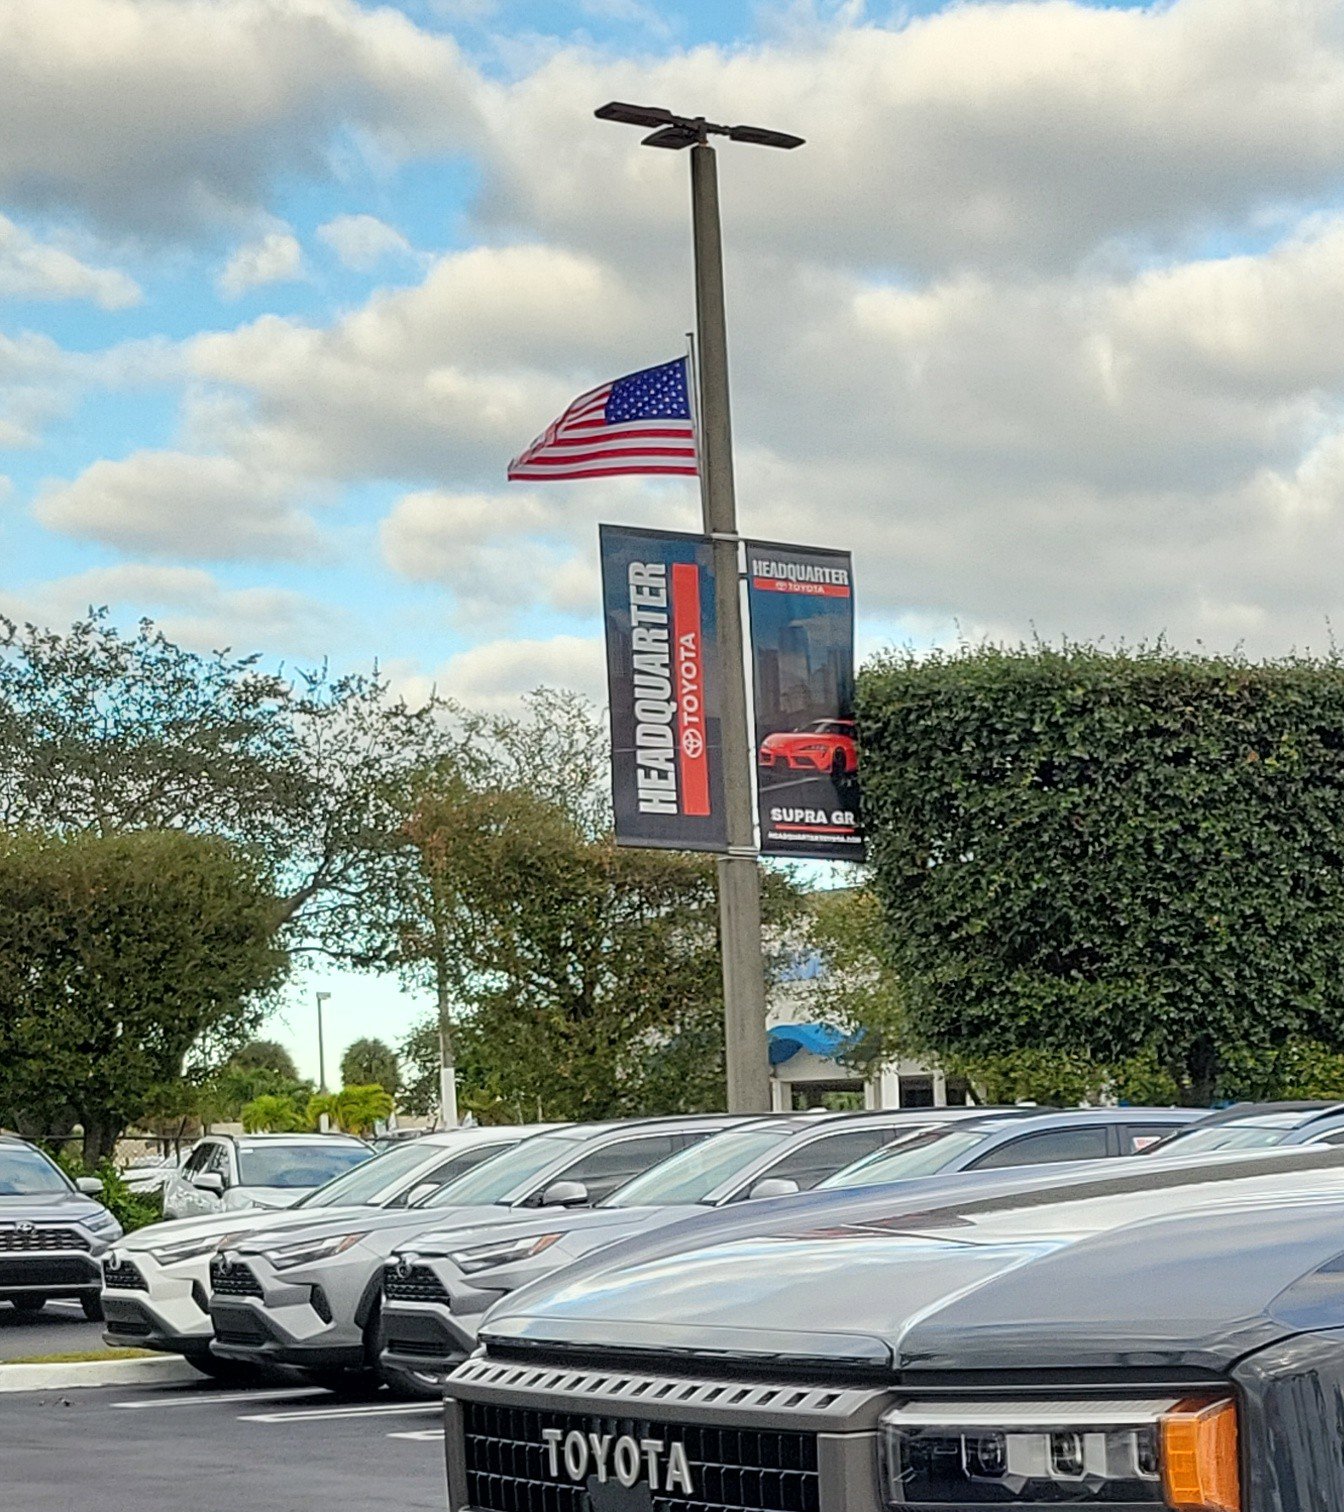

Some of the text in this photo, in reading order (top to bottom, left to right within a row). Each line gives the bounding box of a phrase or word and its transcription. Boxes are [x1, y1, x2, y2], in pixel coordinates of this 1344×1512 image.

[752, 558, 849, 586] HEADQUARTER
[787, 582, 825, 594] TOYOTA
[628, 560, 678, 815] HEADQUARTER
[678, 632, 700, 727] TOYOTA
[770, 806, 856, 826] SUPRA GR
[541, 1427, 694, 1496] TOYOTA
